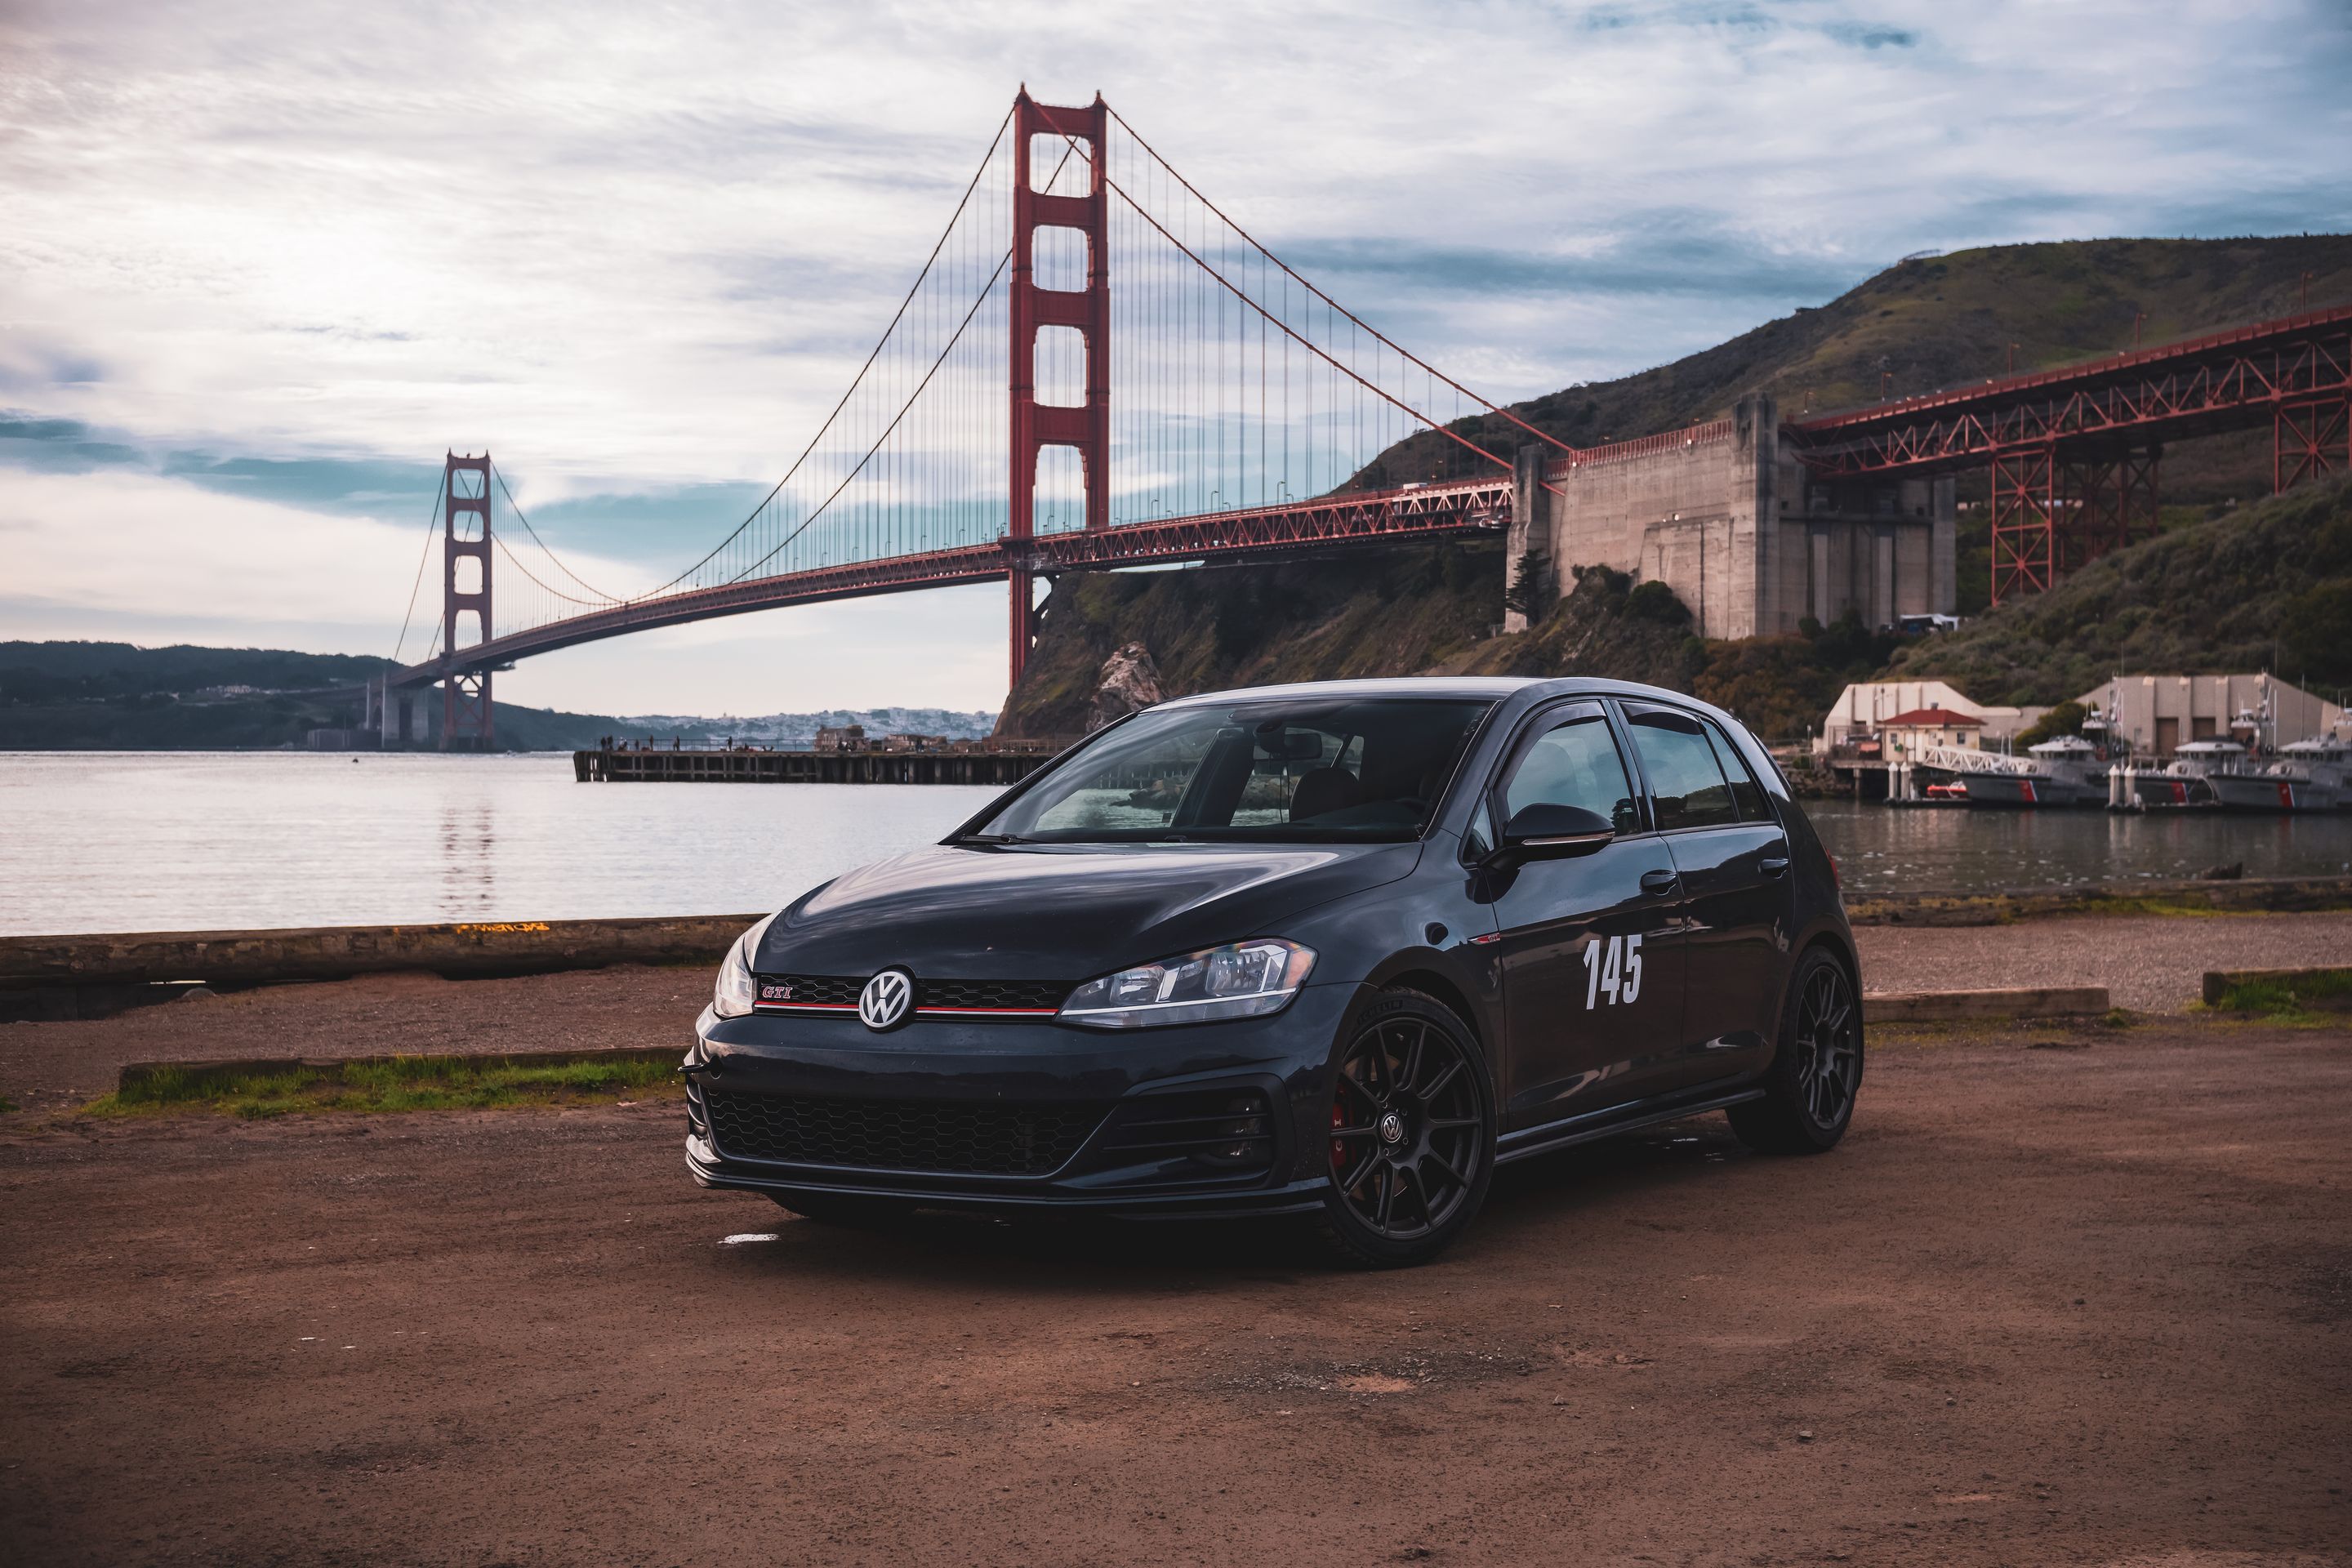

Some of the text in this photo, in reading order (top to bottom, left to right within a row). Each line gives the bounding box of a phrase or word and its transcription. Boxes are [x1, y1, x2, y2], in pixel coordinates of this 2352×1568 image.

[1584, 934, 1642, 1010] 145
[762, 986, 792, 999] GTI
[862, 973, 909, 1026] VW
[1383, 1115, 1401, 1140] VW
